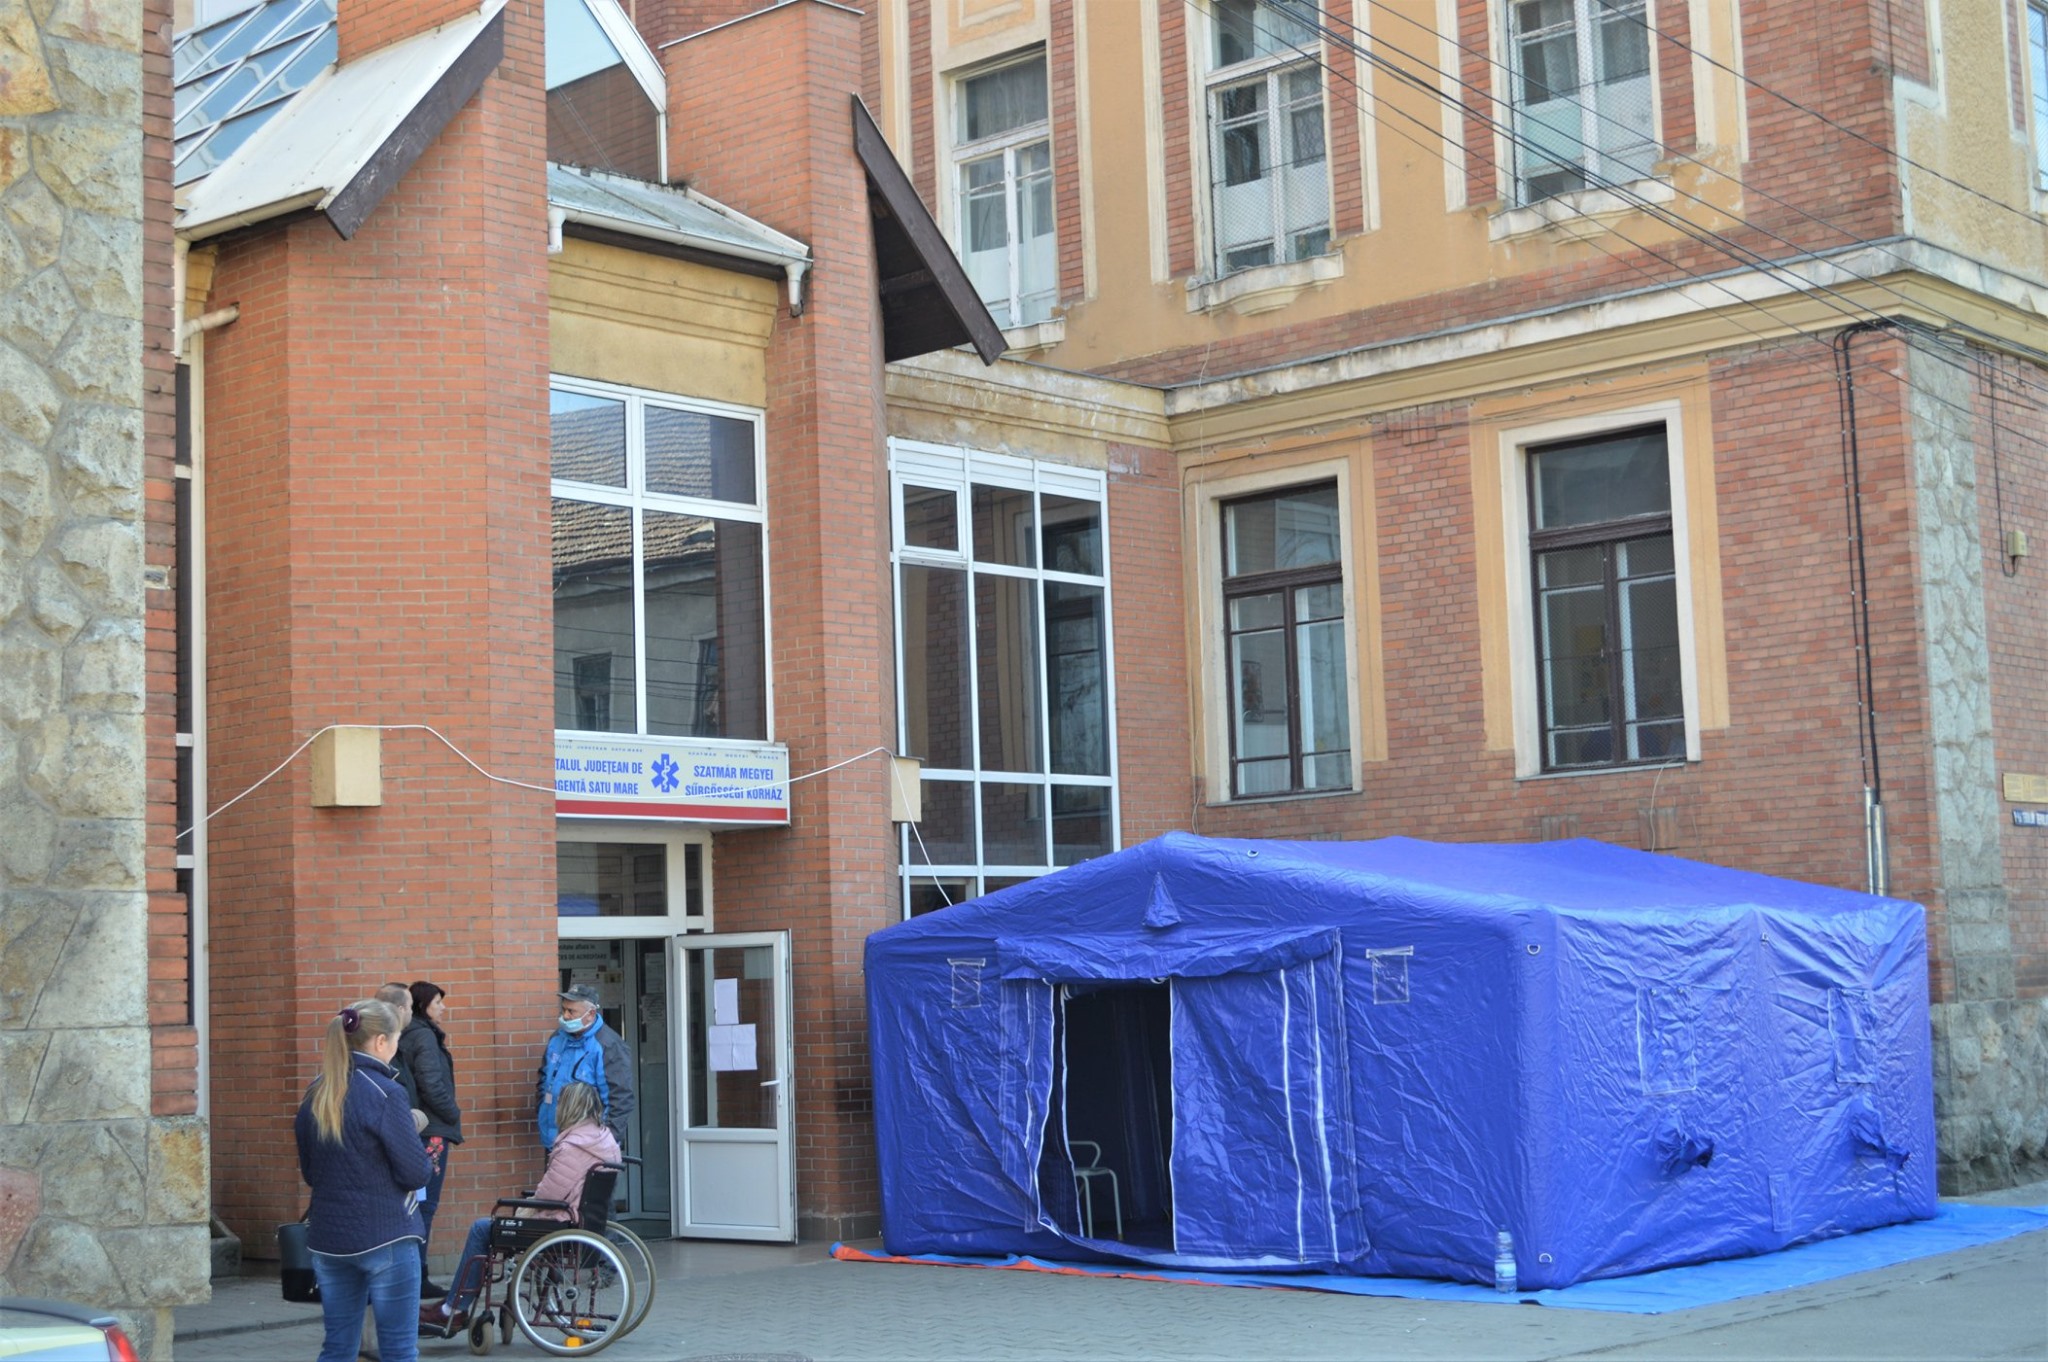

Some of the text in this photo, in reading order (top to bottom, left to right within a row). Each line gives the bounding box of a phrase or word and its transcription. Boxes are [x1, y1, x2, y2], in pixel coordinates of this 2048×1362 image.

[631, 762, 643, 774] DE
[693, 763, 773, 780] SZATMÁR MEGYEI
[589, 781, 611, 794] SATU
[613, 782, 639, 795] MARE
